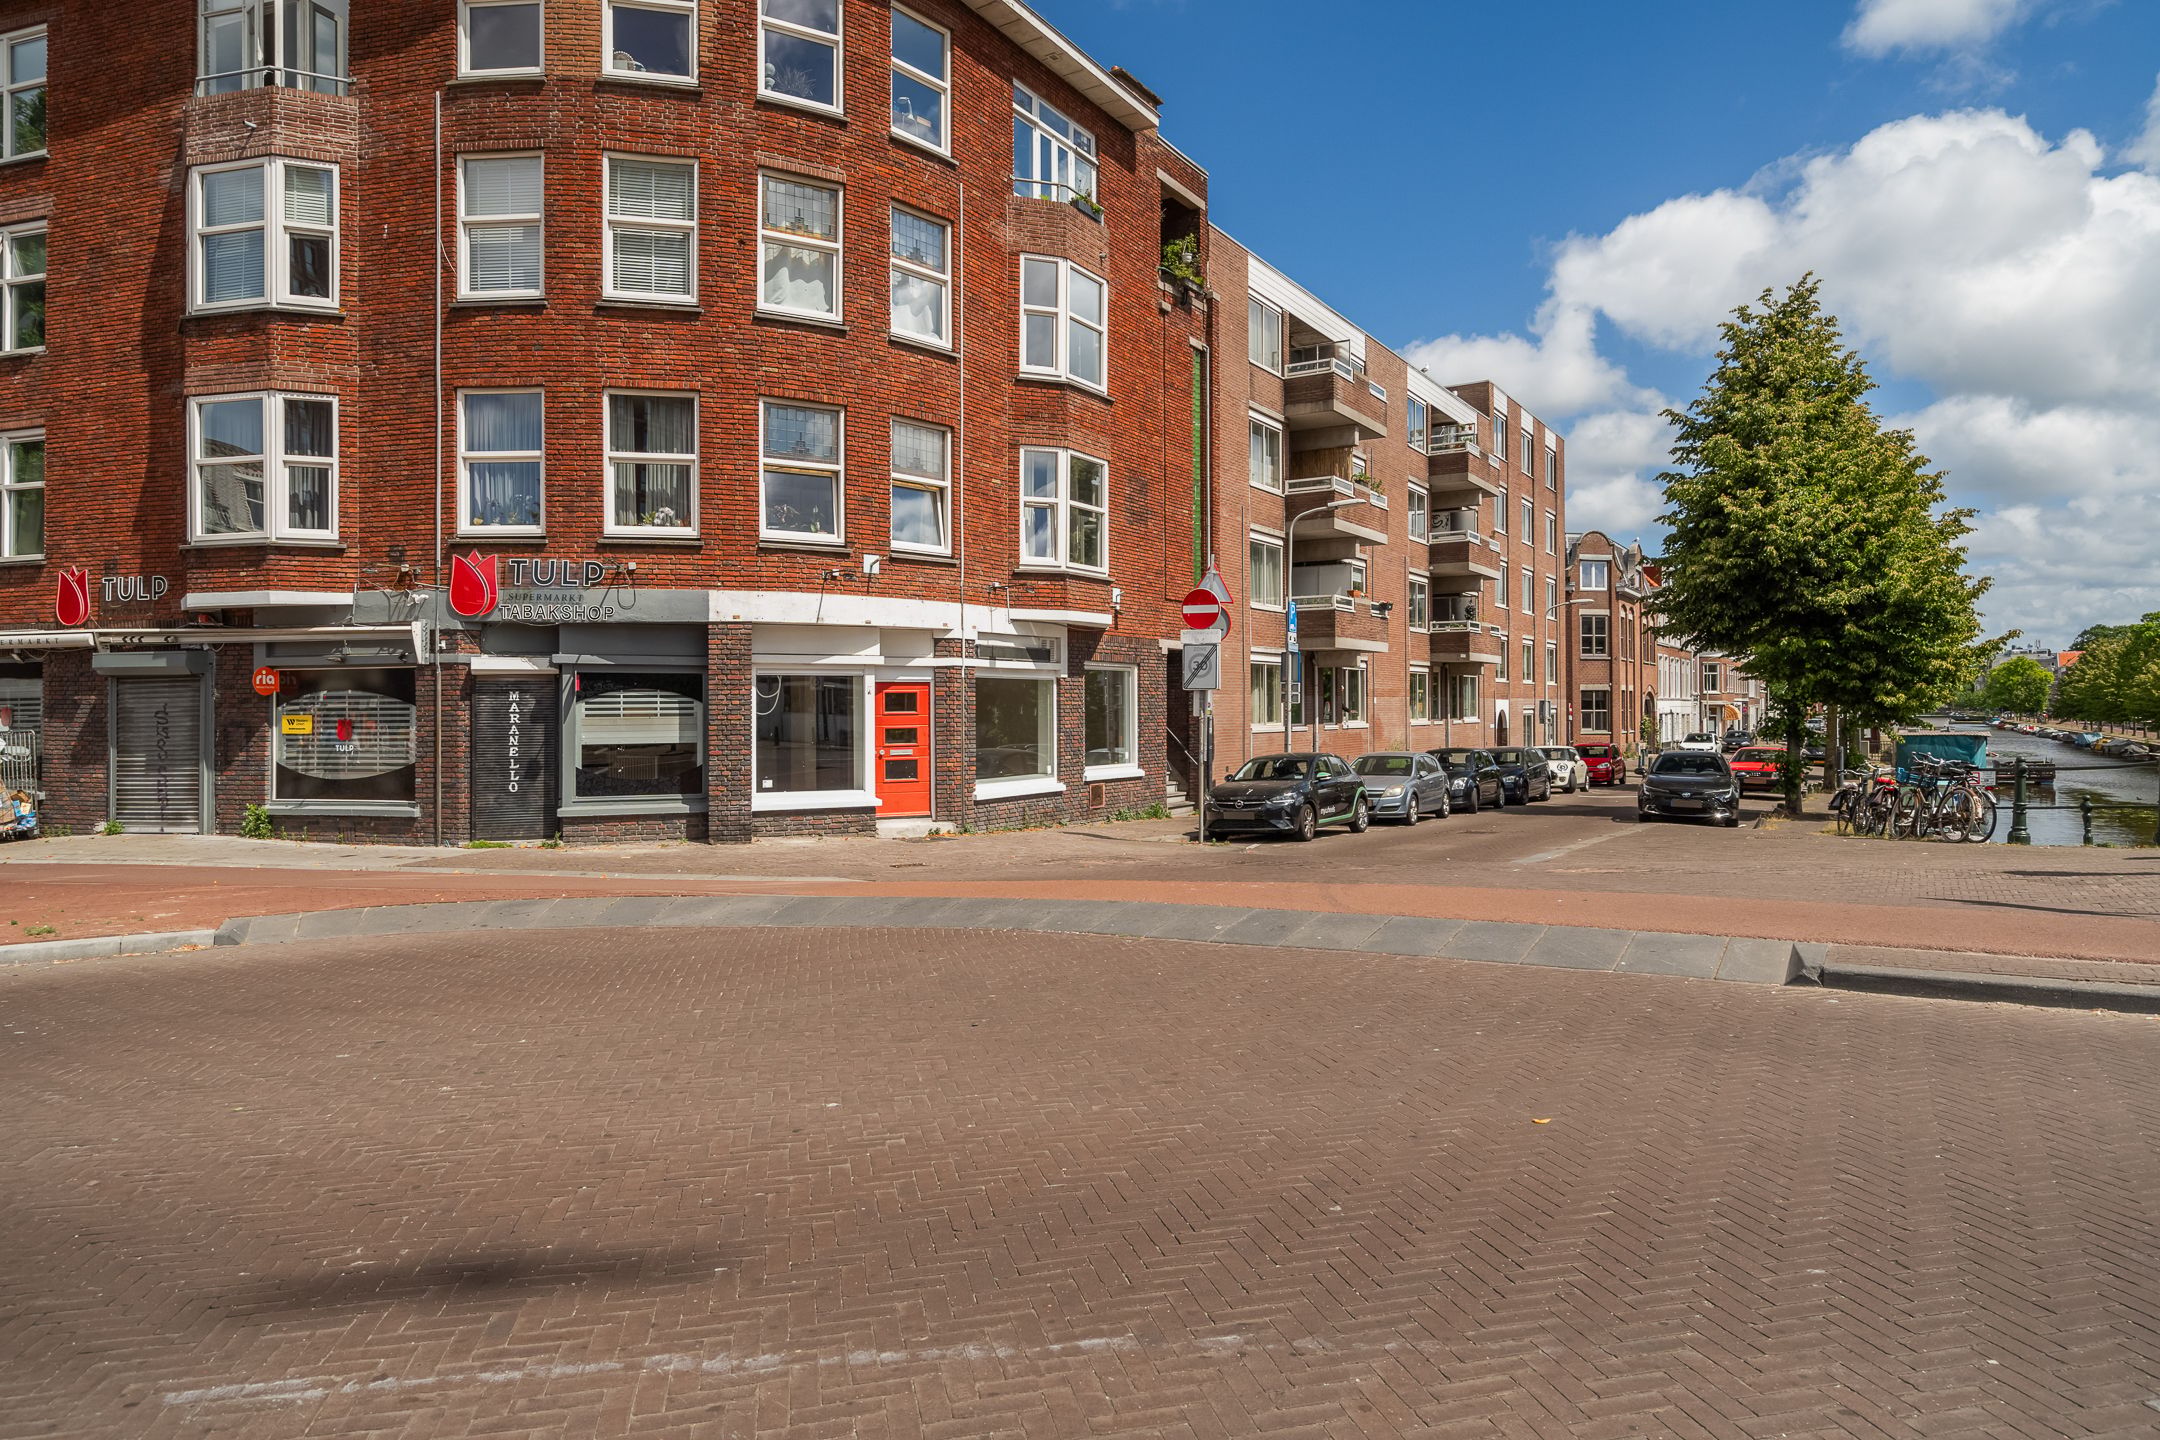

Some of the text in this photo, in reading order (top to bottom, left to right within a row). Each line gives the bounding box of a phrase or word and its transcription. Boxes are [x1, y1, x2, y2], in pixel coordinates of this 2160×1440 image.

[509, 558, 605, 587] TULP
[102, 575, 168, 601] TULP
[508, 592, 584, 602] SUPERMARKT
[500, 603, 615, 621] TABAKSHOP
[255, 669, 275, 685] ria
[335, 744, 354, 752] TULP
[508, 690, 521, 793] MARANELLO
